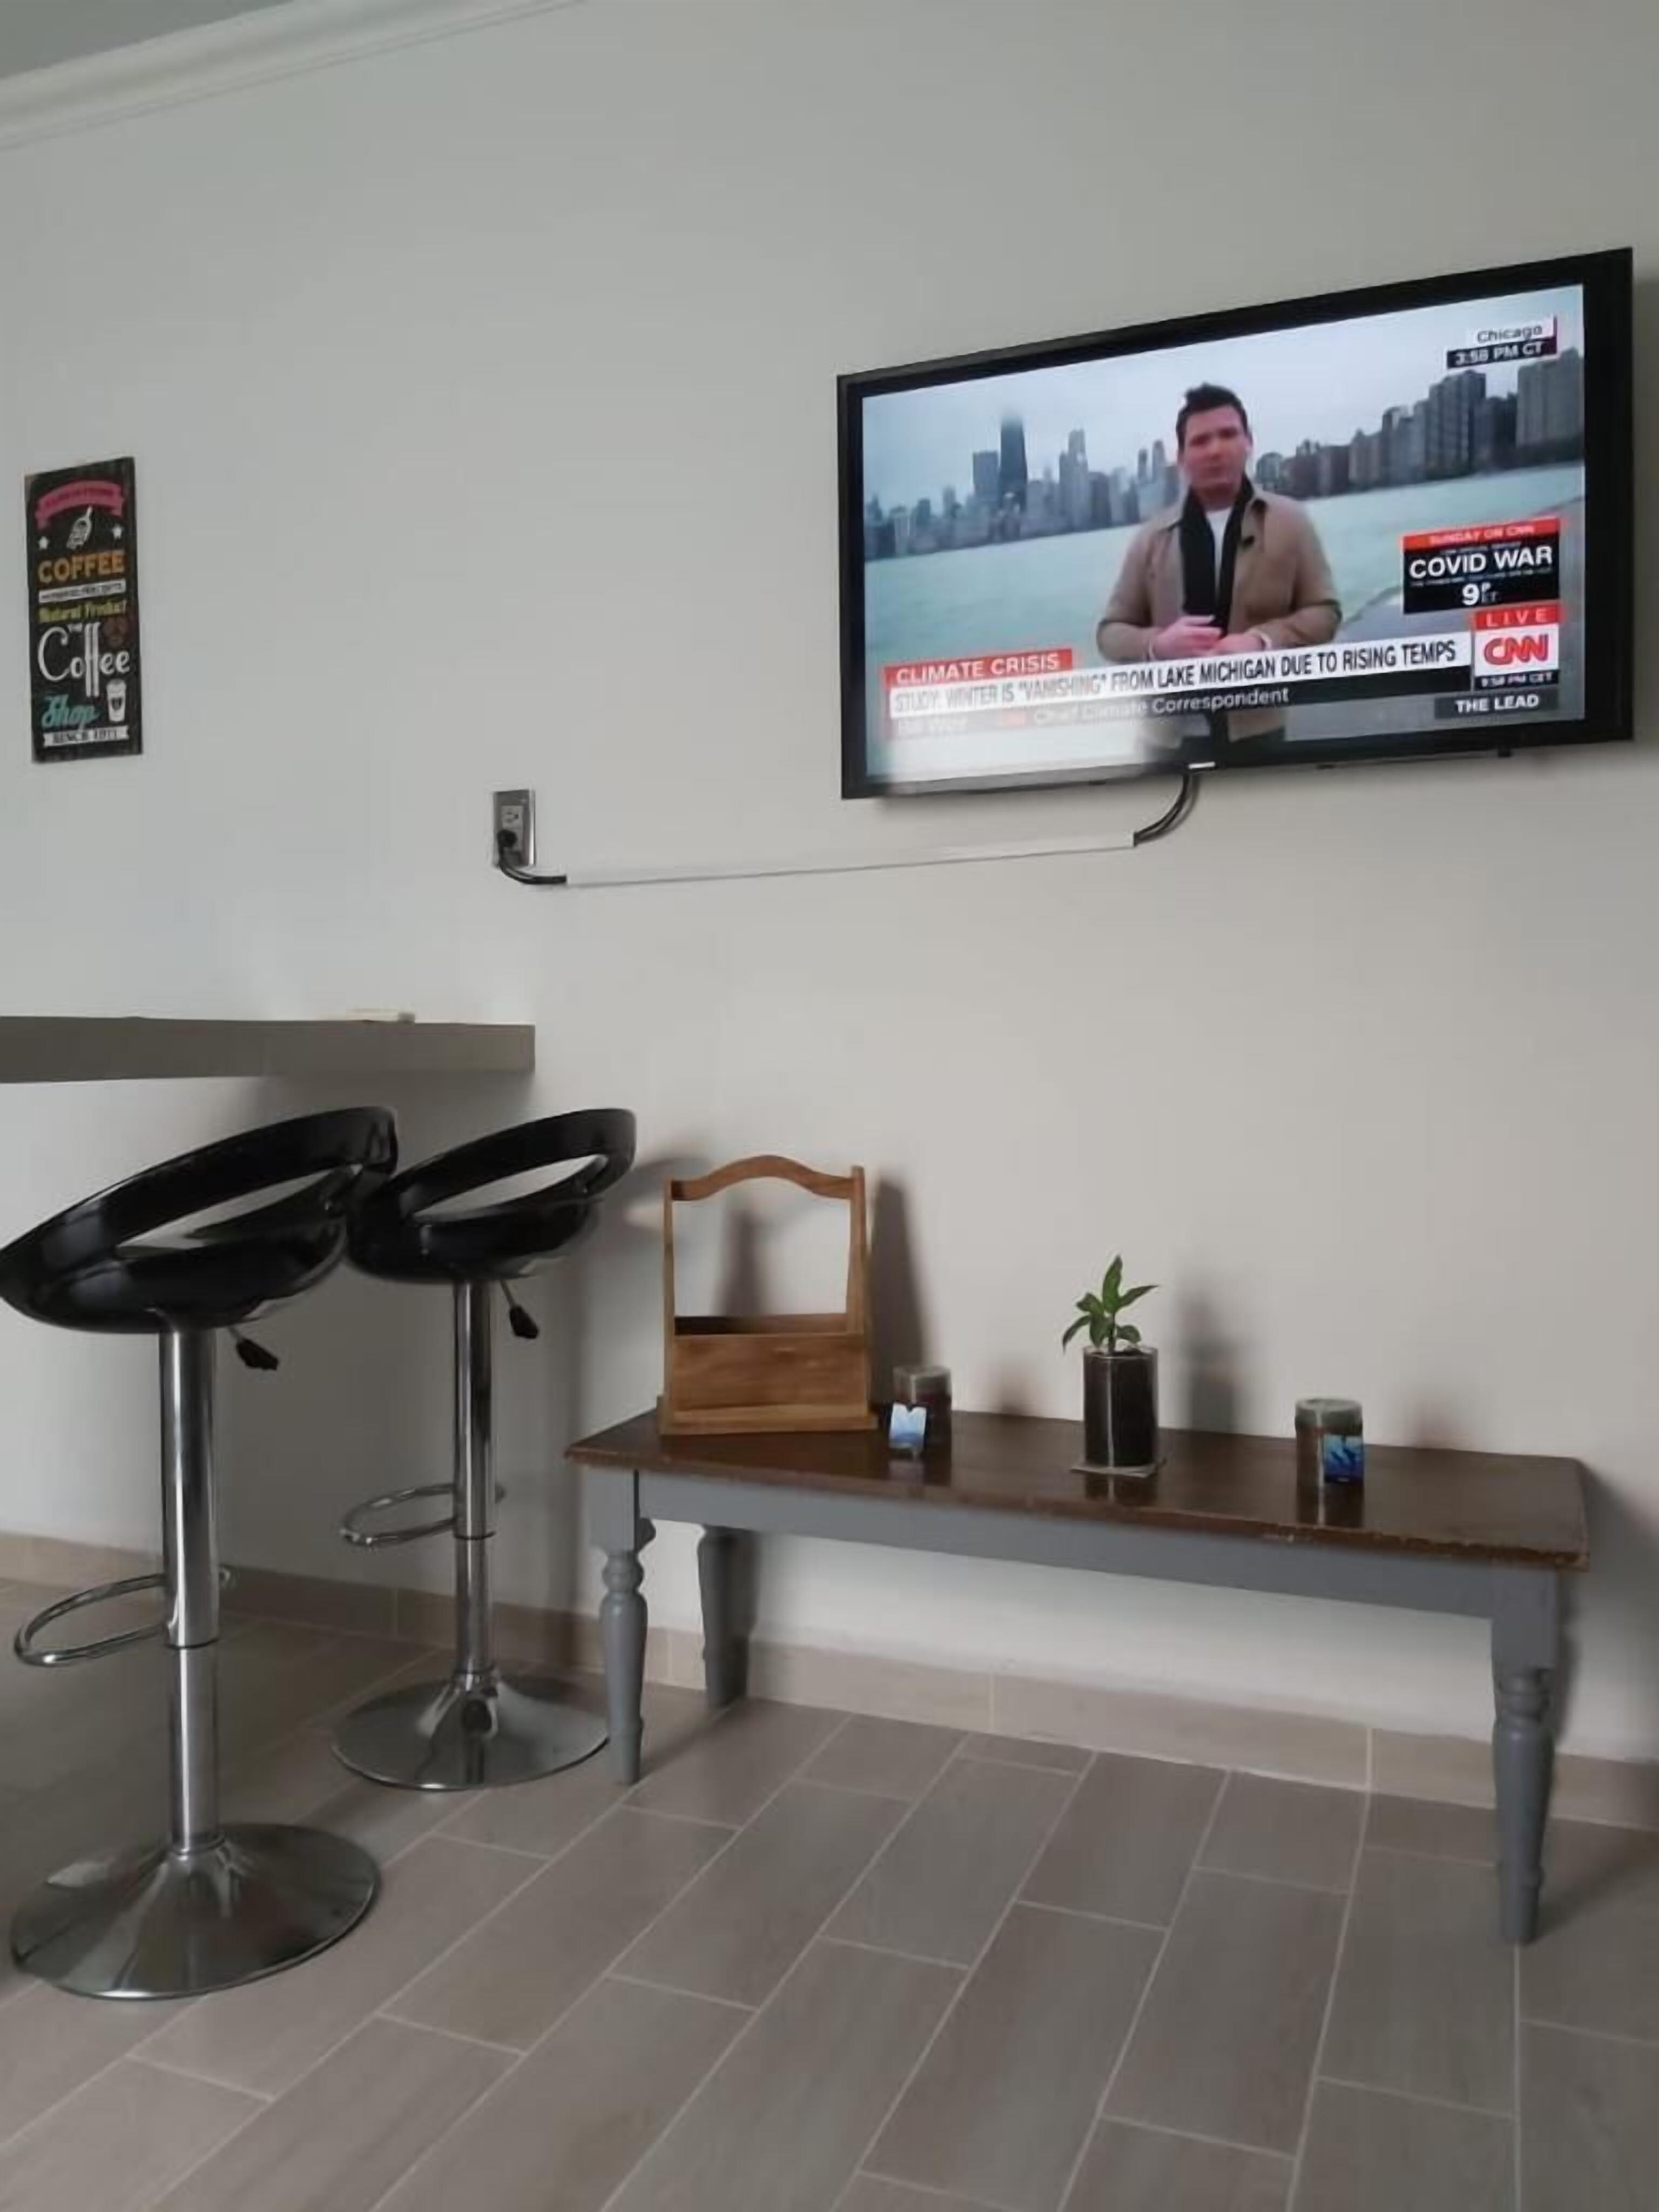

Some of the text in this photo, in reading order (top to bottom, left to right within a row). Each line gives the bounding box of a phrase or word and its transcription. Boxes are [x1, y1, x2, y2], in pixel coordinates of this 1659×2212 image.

[1478, 326, 1542, 343] Chicago
[1493, 345, 1519, 359] PM
[1522, 341, 1543, 355] CT
[38, 550, 125, 583] COFFEE
[1410, 553, 1486, 578] COVID
[1494, 545, 1553, 569] WAR
[1486, 608, 1547, 627] LIVE
[38, 622, 130, 697] Coffee
[1484, 634, 1549, 665] CNN
[896, 652, 1059, 684] CLIMATE CRISIS
[1002, 682, 1014, 702] IS
[1112, 670, 1154, 691] FROM
[1158, 665, 1195, 687] LAKE
[1200, 656, 1274, 684] MICHIGAN
[1281, 654, 1312, 676] DUE
[1318, 651, 1337, 672] TO
[1343, 646, 1396, 671] RISING
[1402, 639, 1456, 665] TEMPS
[1154, 688, 1289, 714] Correspondent
[1456, 693, 1539, 713] THE LEAD
